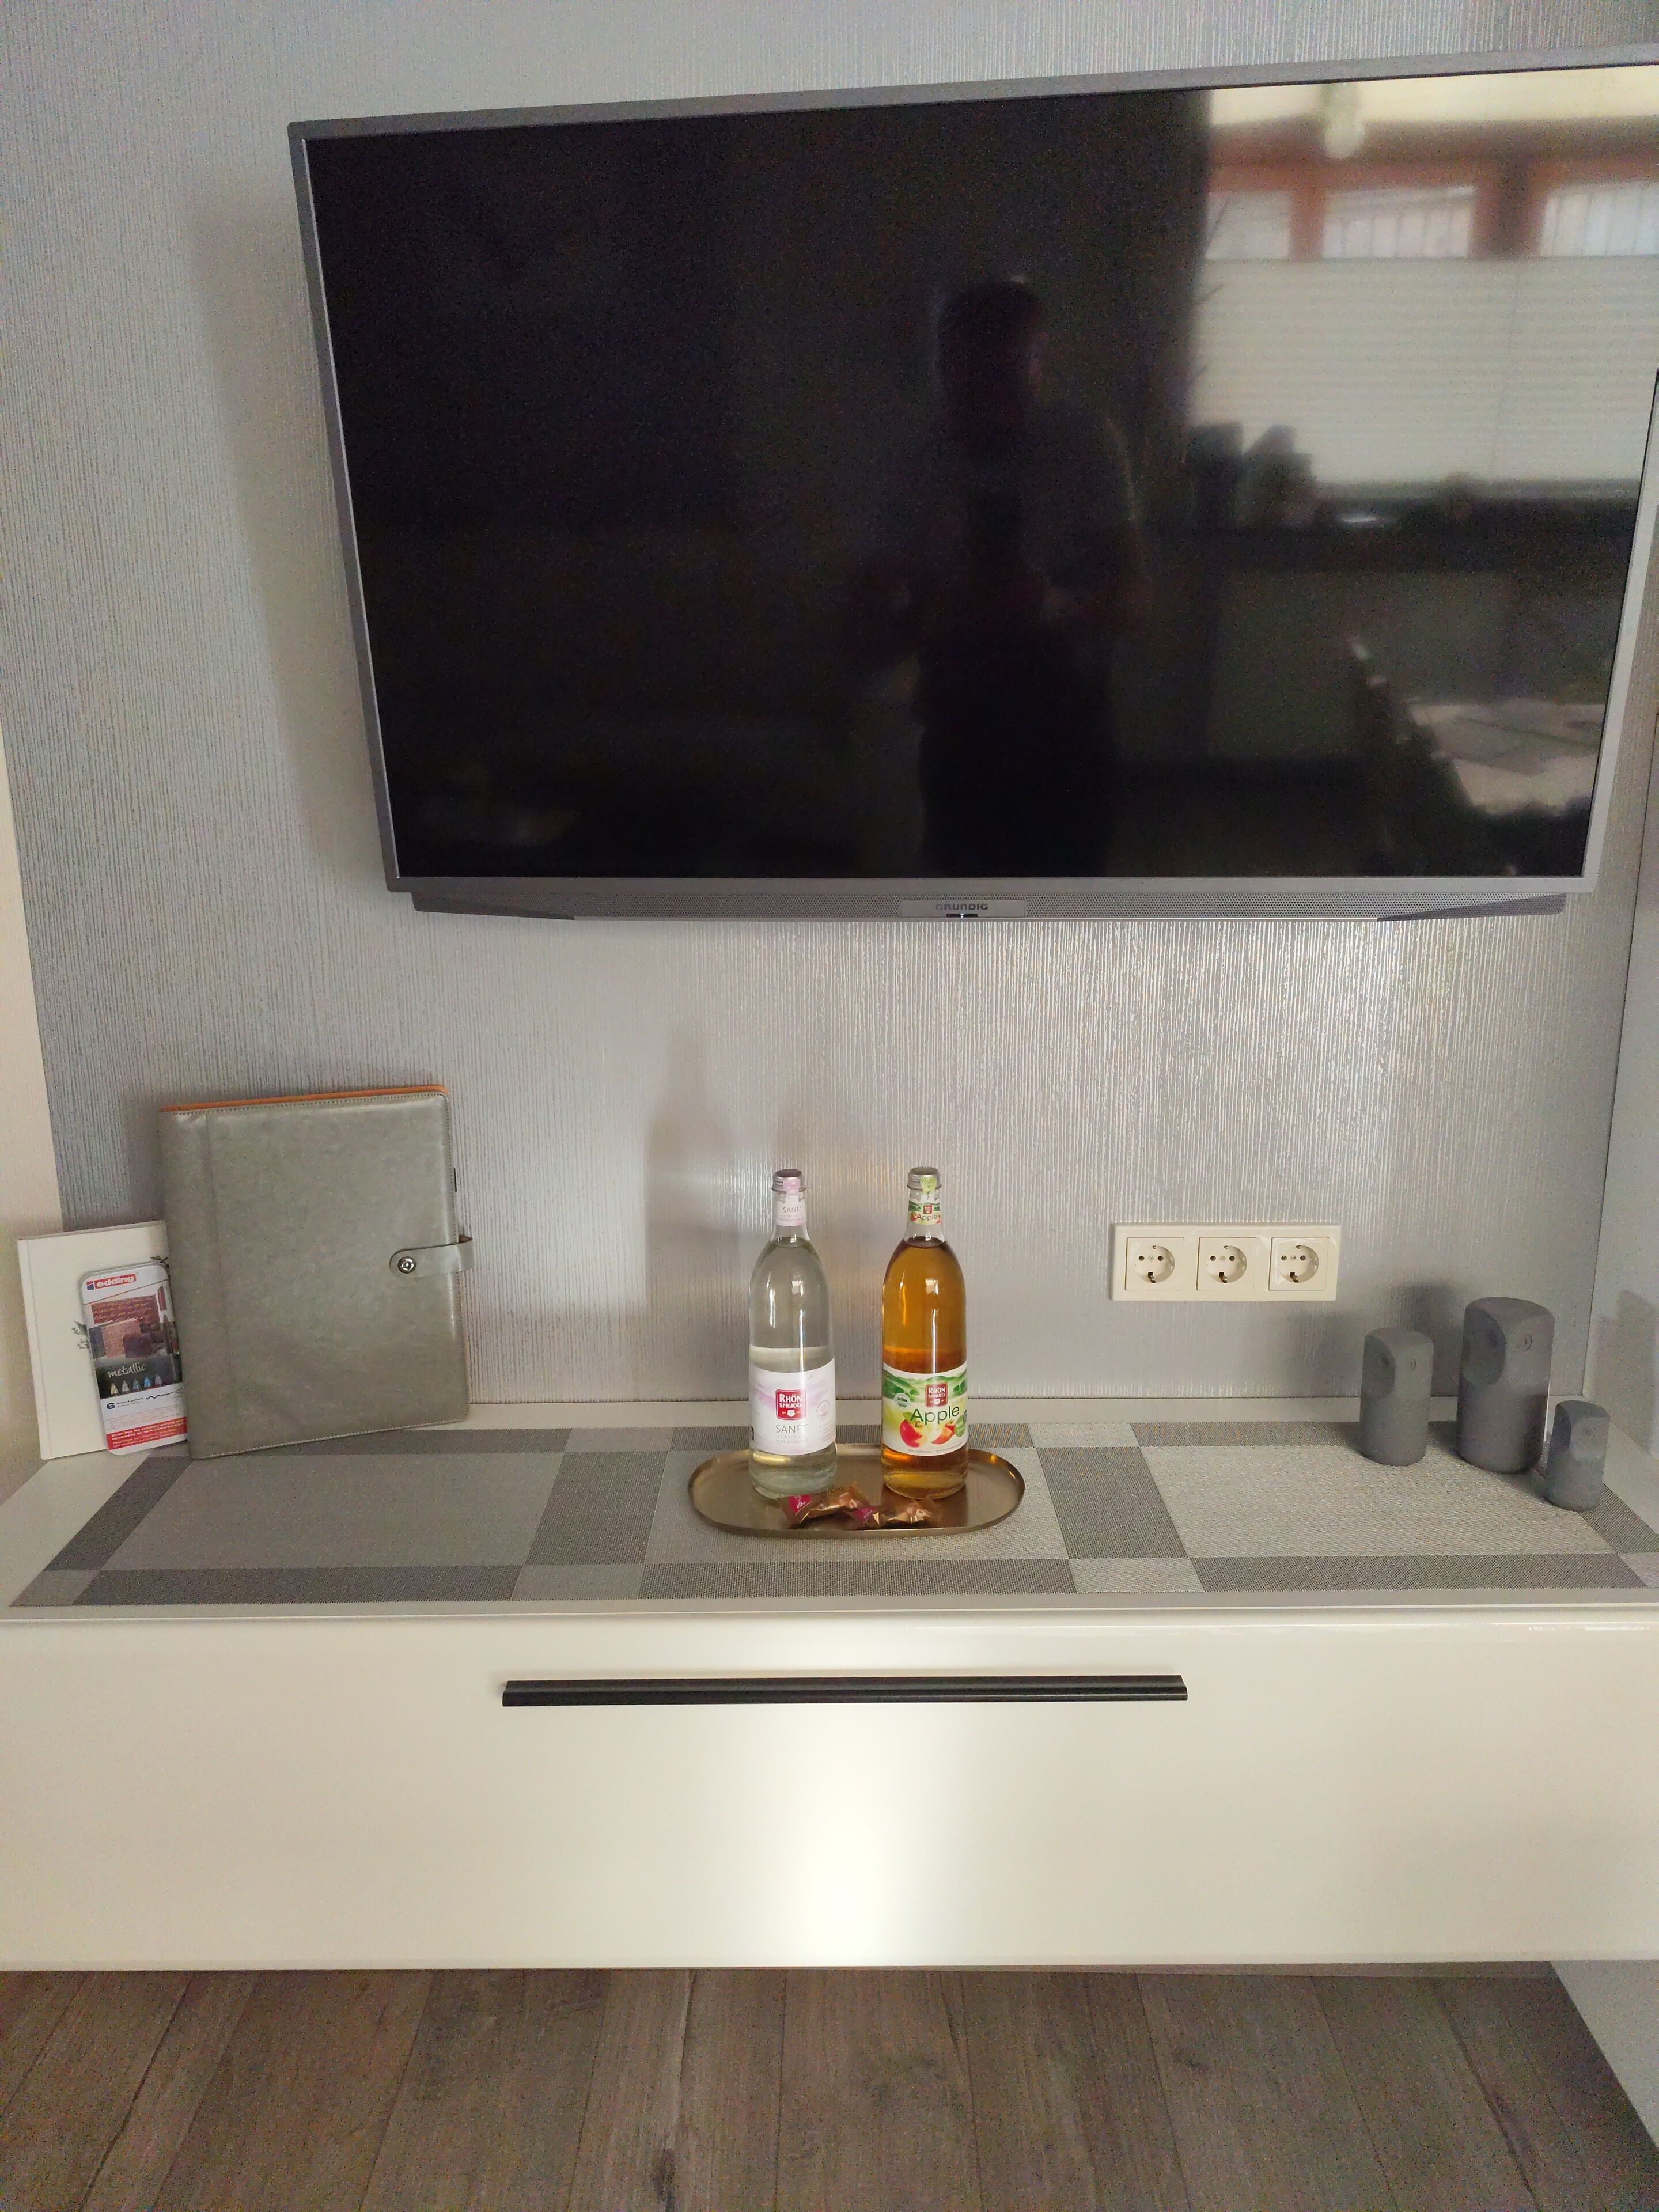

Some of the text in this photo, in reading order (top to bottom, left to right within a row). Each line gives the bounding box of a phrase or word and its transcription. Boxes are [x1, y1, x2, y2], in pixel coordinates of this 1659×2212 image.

[916, 1213, 938, 1222] Apple
[96, 1275, 135, 1287] edding
[108, 1361, 146, 1378] metallic
[779, 1393, 802, 1403] RHÖN
[910, 1406, 960, 1426] Apple
[775, 1424, 808, 1434] SANFT
